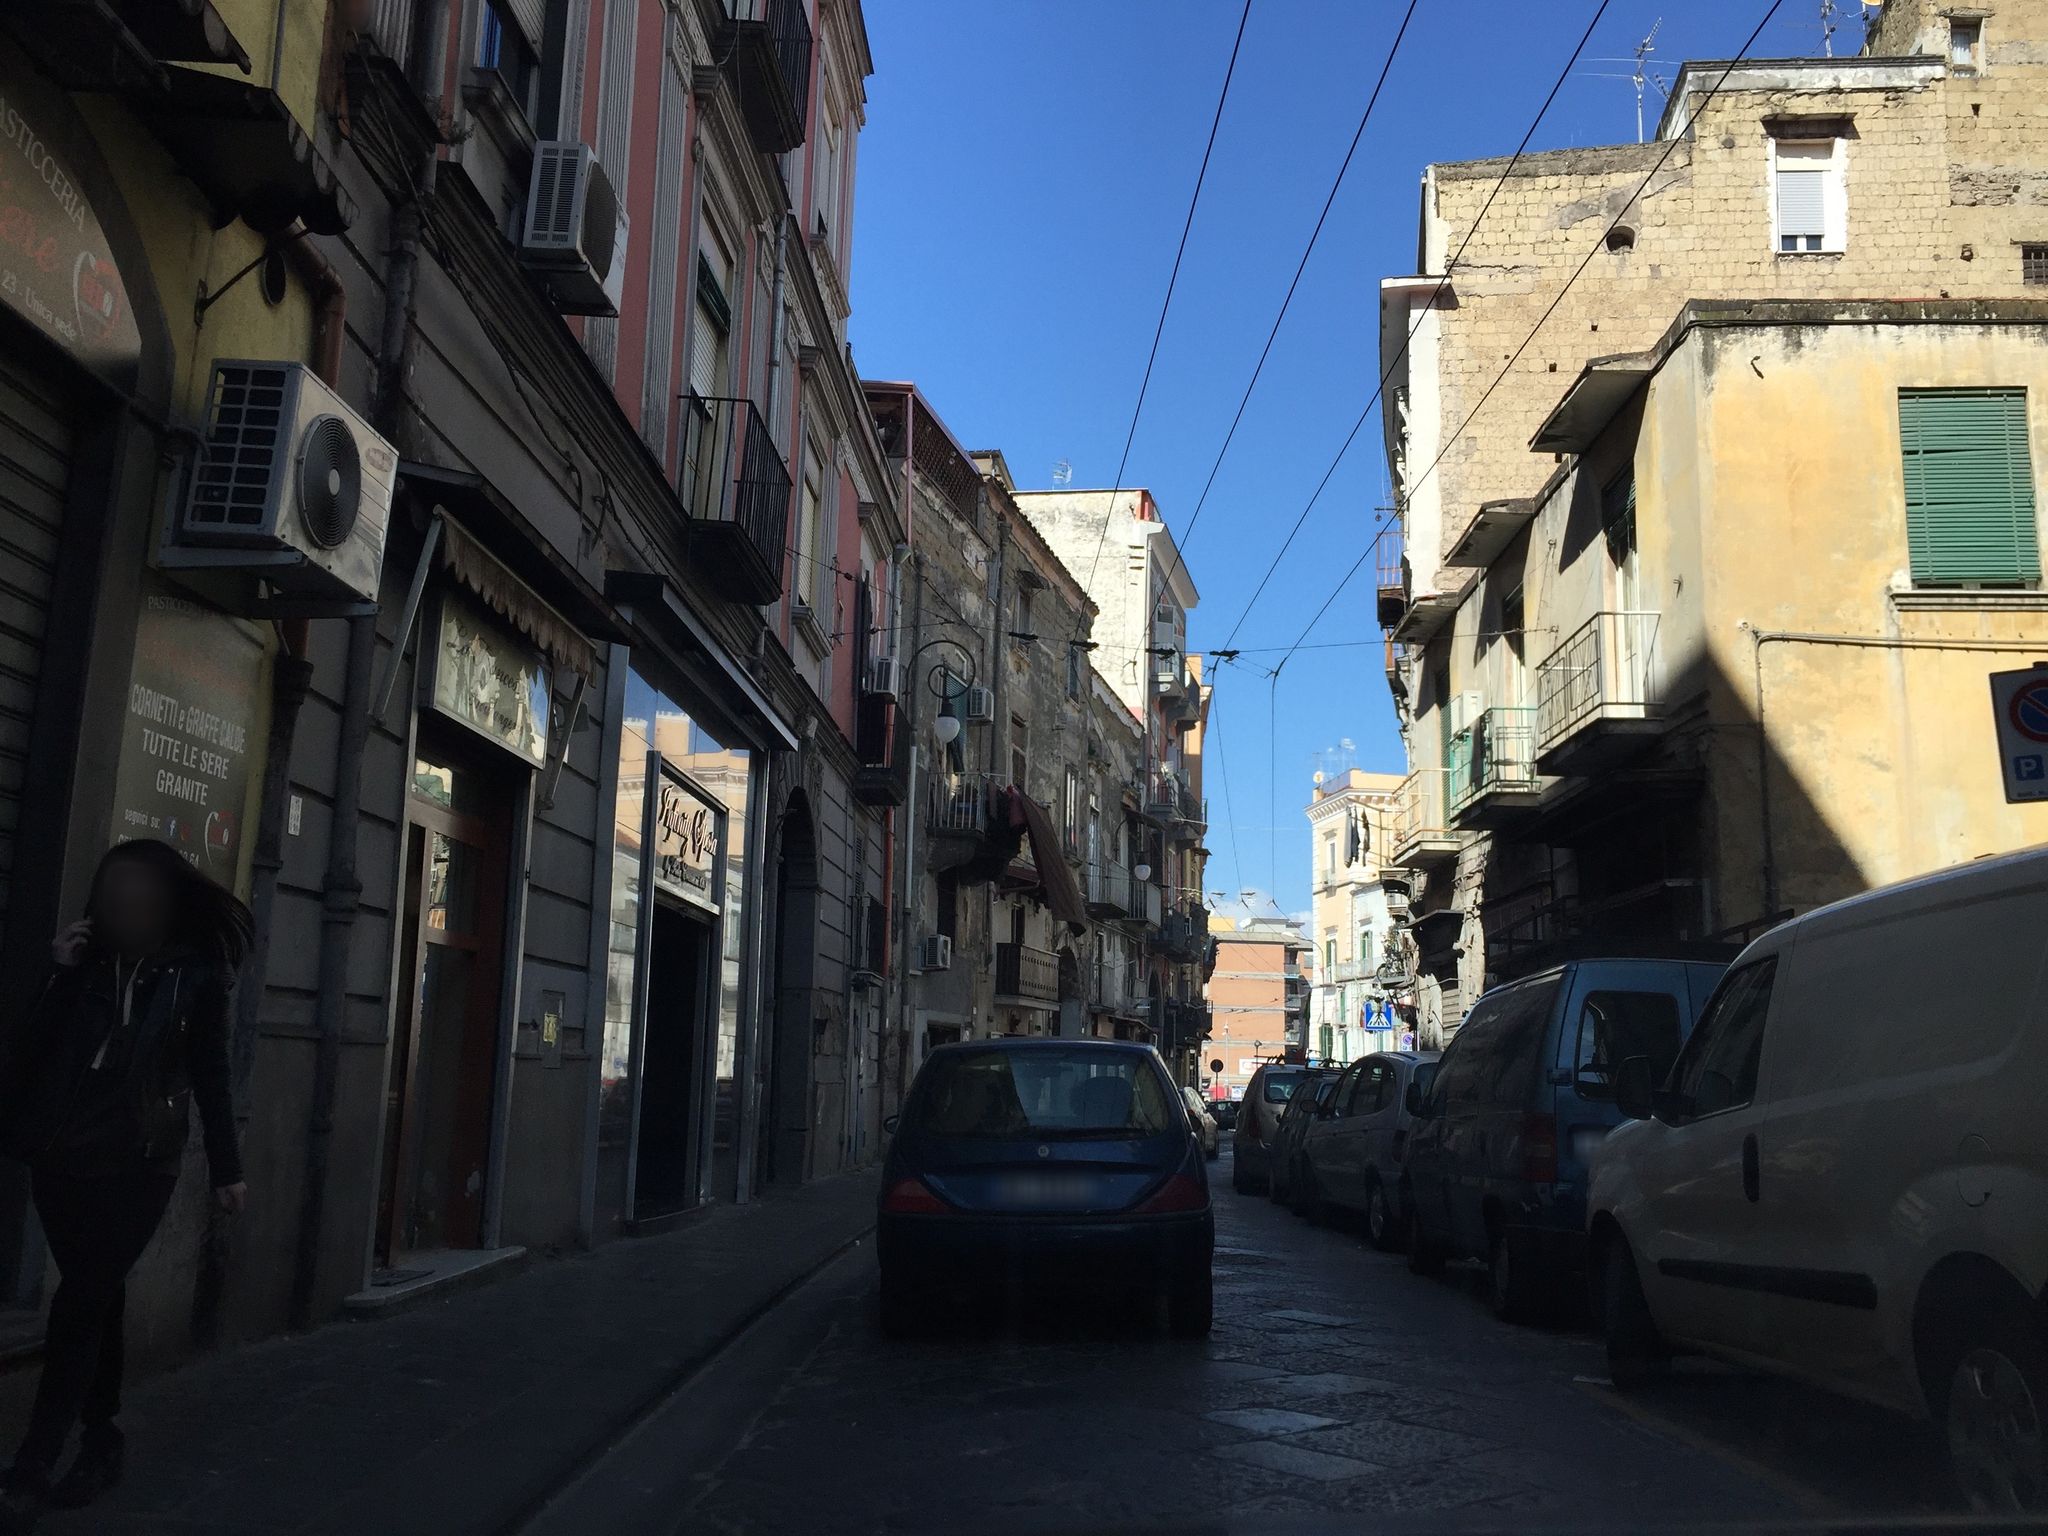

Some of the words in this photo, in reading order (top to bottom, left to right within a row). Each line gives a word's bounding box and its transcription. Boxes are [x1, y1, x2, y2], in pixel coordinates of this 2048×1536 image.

[131, 684, 179, 728] CORNETTI
[178, 709, 185, 731] e
[185, 706, 220, 744] GRAFFE
[143, 728, 181, 763] TUTTE
[182, 743, 199, 769] LE
[199, 749, 230, 780] SERE
[156, 769, 209, 806] GRANITE
